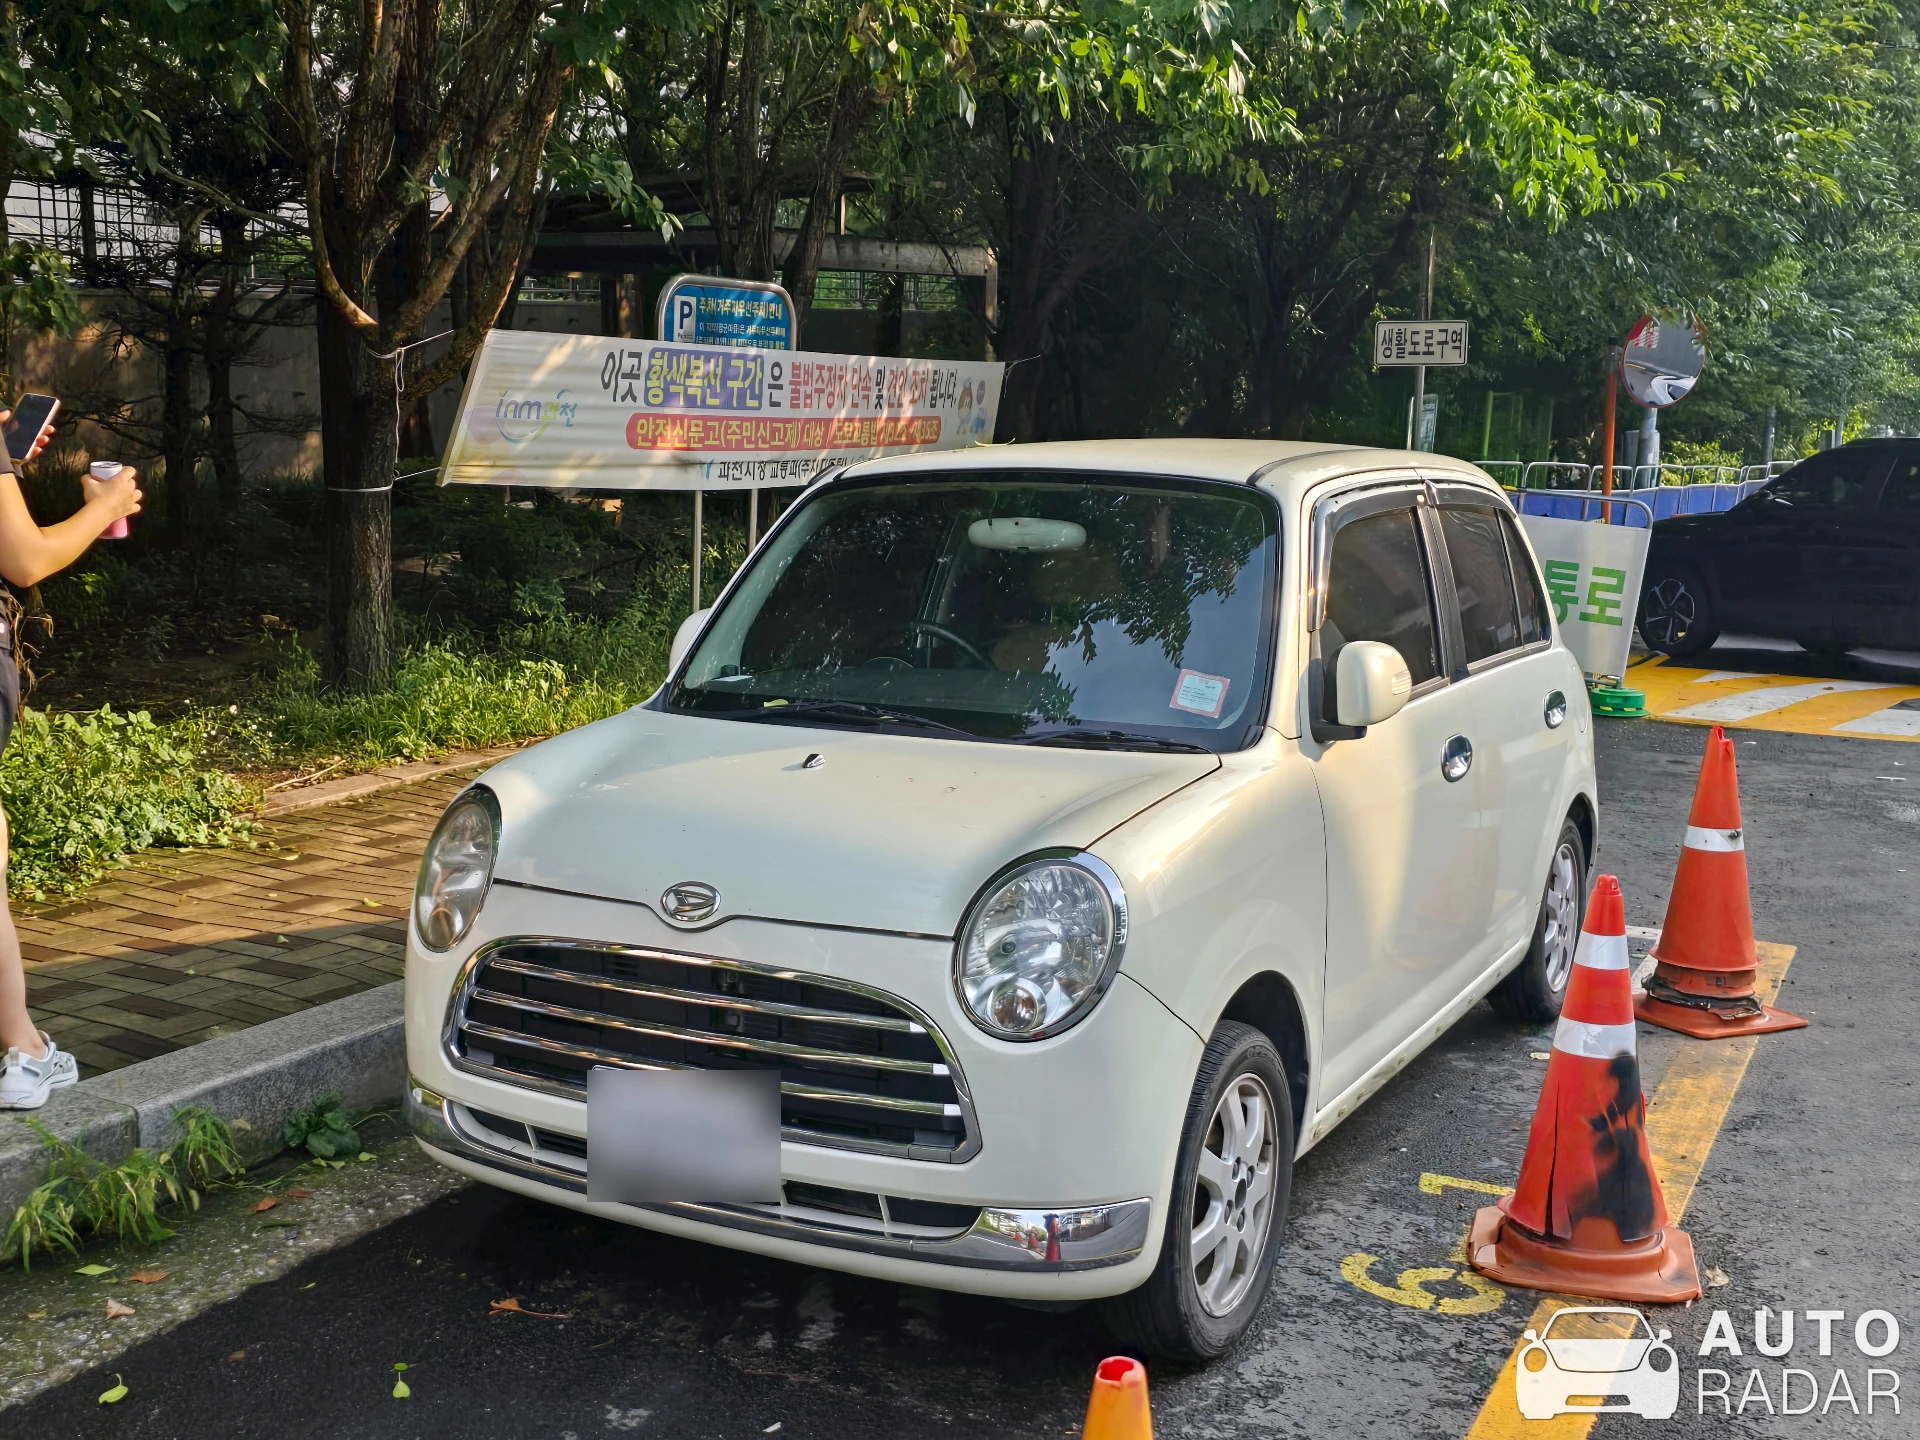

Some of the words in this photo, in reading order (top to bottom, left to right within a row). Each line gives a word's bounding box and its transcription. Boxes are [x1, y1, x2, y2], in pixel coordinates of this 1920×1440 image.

[679, 301, 693, 329] P
[1381, 327, 1463, 359] 생활도로구역
[601, 349, 642, 403] 이곳
[646, 351, 723, 407] 황색복선
[727, 358, 763, 407] 구간
[768, 361, 784, 407] 은
[789, 361, 848, 410] 불법주정차
[851, 363, 873, 410] 단속
[875, 365, 886, 410] 및
[887, 365, 908, 409] 견인
[909, 367, 929, 408] 조치
[930, 368, 957, 408] 됩니다.
[636, 416, 800, 449] 안전신문고(주민신고제)
[804, 420, 825, 447] 대상
[833, 419, 878, 446] 도로교통법
